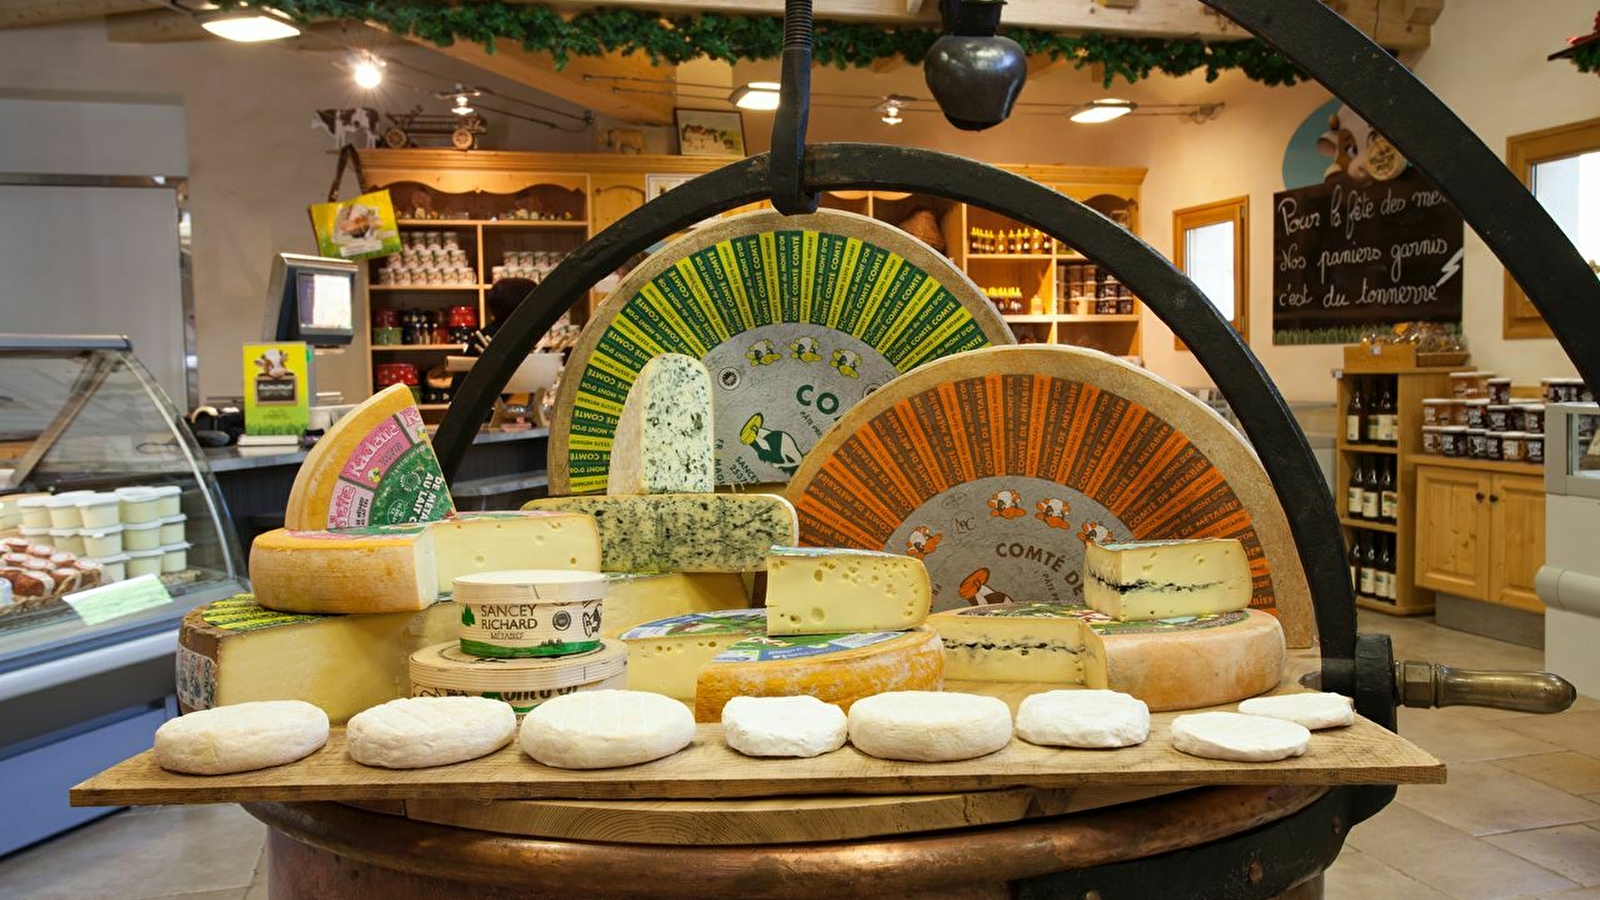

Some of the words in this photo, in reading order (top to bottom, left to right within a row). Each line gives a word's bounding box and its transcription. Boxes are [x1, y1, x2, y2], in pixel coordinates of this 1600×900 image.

[1279, 197, 1320, 236] Pour
[1330, 185, 1343, 228] la
[1346, 191, 1376, 239] fête
[1381, 188, 1406, 215] des
[1412, 190, 1448, 207] me
[747, 238, 760, 269] COMTÉ
[790, 235, 799, 265] COMTÉ
[829, 239, 843, 270] COMTÉ
[1280, 243, 1307, 272] Nos
[1317, 240, 1382, 284] paniers
[1391, 237, 1448, 282] garnis
[705, 250, 724, 280] COMTÉ
[855, 282, 871, 308] COMTÉ
[866, 251, 884, 282] COMTÉ
[667, 270, 690, 299] COMTÉ
[718, 281, 734, 307] COMTÉ
[754, 271, 765, 298] COMTÉ
[824, 272, 835, 298] COMTÉ
[884, 300, 904, 324] COMTÉ
[900, 272, 923, 301] COMTÉ
[1279, 284, 1313, 306] c'est
[1323, 285, 1349, 308] du
[1357, 277, 1439, 305] tonnerre
[633, 296, 660, 323] COMTÉ
[686, 298, 705, 323] COMTÉ
[909, 323, 932, 346] COMTÉ
[929, 299, 956, 326] COMTÉ
[606, 329, 635, 353] COMTÉ
[657, 320, 680, 344] COMTÉ
[586, 368, 616, 386] COMTÉ
[796, 384, 840, 416] CO
[574, 409, 604, 423] COMTÉ
[570, 453, 600, 462] COMTÉ
[730, 466, 747, 483] 2537
[417, 492, 438, 522] MÉTA
[996, 542, 1065, 572] COMTÉ
[1064, 570, 1084, 597] DE
[481, 604, 537, 617] SANCEY
[481, 619, 538, 629] RICHARD
